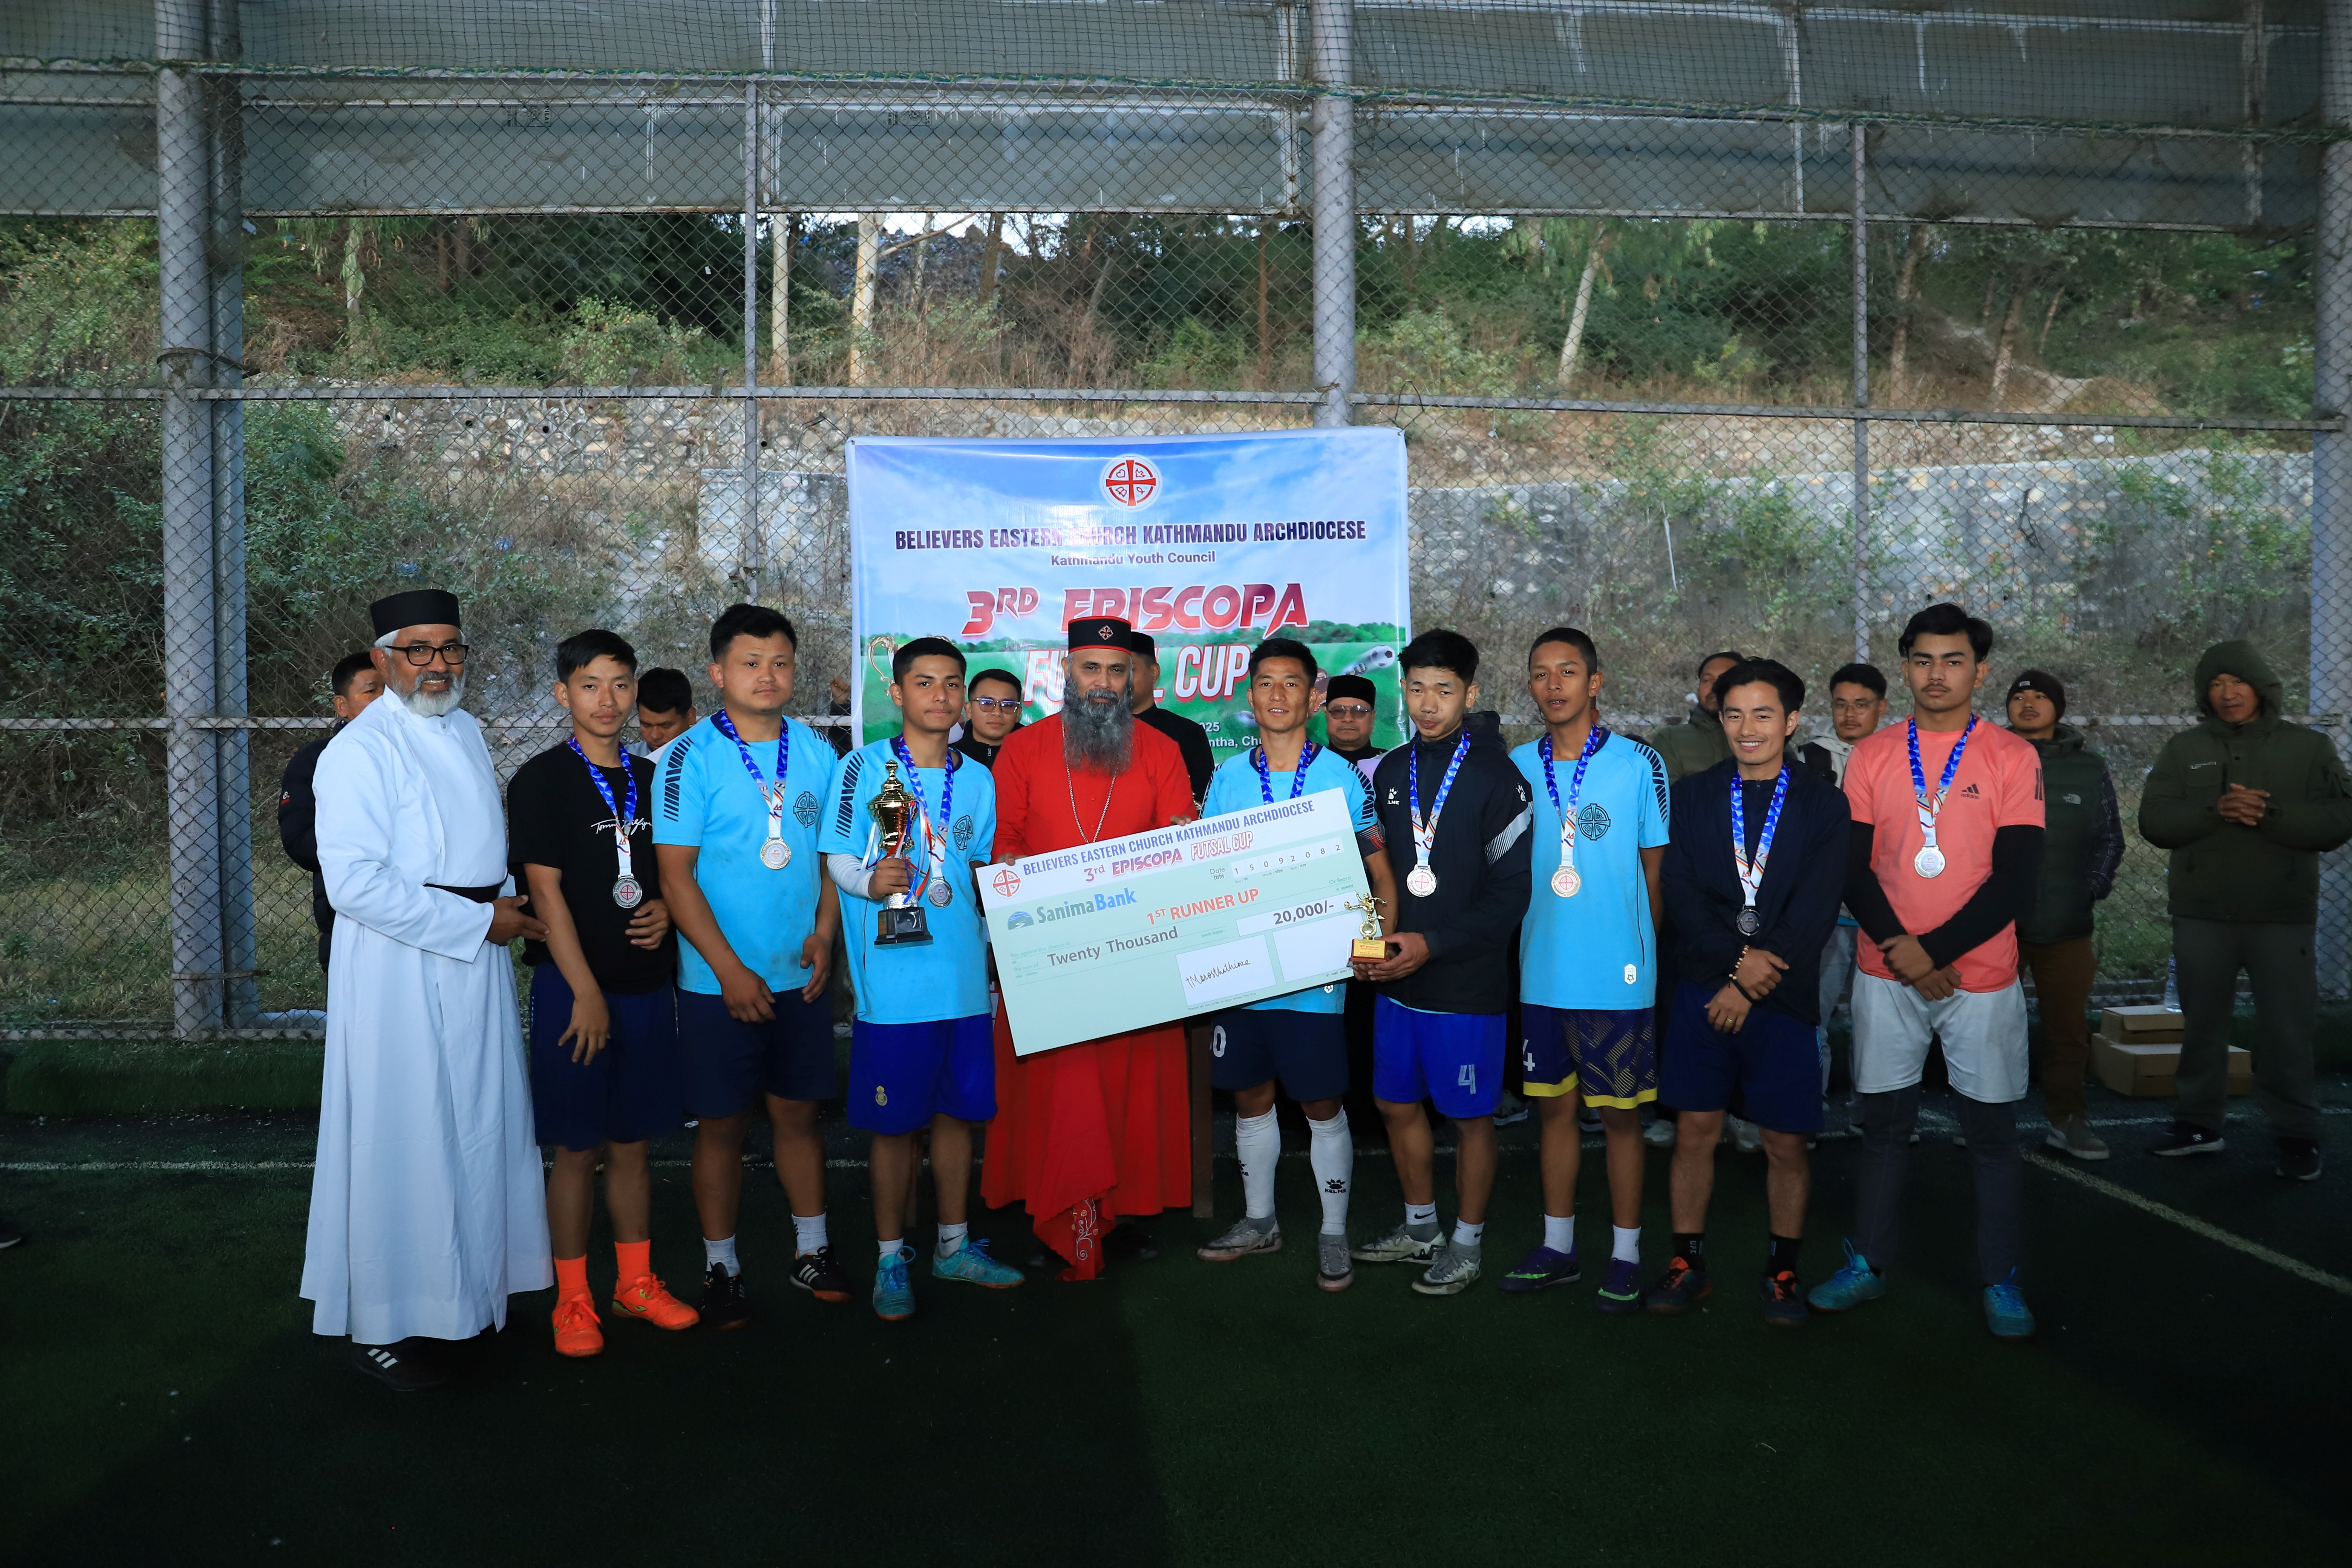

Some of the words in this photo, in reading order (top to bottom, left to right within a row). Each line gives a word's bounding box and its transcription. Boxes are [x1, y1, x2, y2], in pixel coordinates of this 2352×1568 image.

[896, 529, 984, 550] BELIEVERS
[989, 527, 1063, 548] EASTERN
[1067, 525, 1137, 547] CHURCH
[1143, 522, 1248, 544] KATHMANDU
[1253, 520, 1366, 542] ARCHDIOCESE
[1051, 553, 1124, 566] Kathmandu
[1127, 552, 1165, 565] Youth
[1168, 551, 1216, 563] Council
[961, 587, 1040, 636] 3RD
[1174, 644, 1252, 702] CUP
[1023, 854, 1078, 876] BELIEVERS
[1081, 843, 1126, 863] EASTERN
[1129, 832, 1173, 853] CHURCH
[1176, 818, 1240, 842] KATHMANDU
[1243, 800, 1315, 827] ARCHDIOCESE
[1084, 864, 1105, 882] 3rd
[1112, 848, 1183, 876] EPISCOPA
[1190, 836, 1231, 861] FUTSAL
[1232, 831, 1254, 850] CUP
[1037, 887, 1137, 925] SanimaBank
[1147, 908, 1166, 925] 1ST
[1170, 894, 1236, 920] RUNNER
[1237, 888, 1259, 904] UP
[1273, 900, 1334, 925] 20,000/-
[1020, 949, 1038, 957] against
[1047, 946, 1101, 966] Twenty
[1106, 926, 1179, 953] Thousand
[1458, 1064, 1476, 1095] 4
